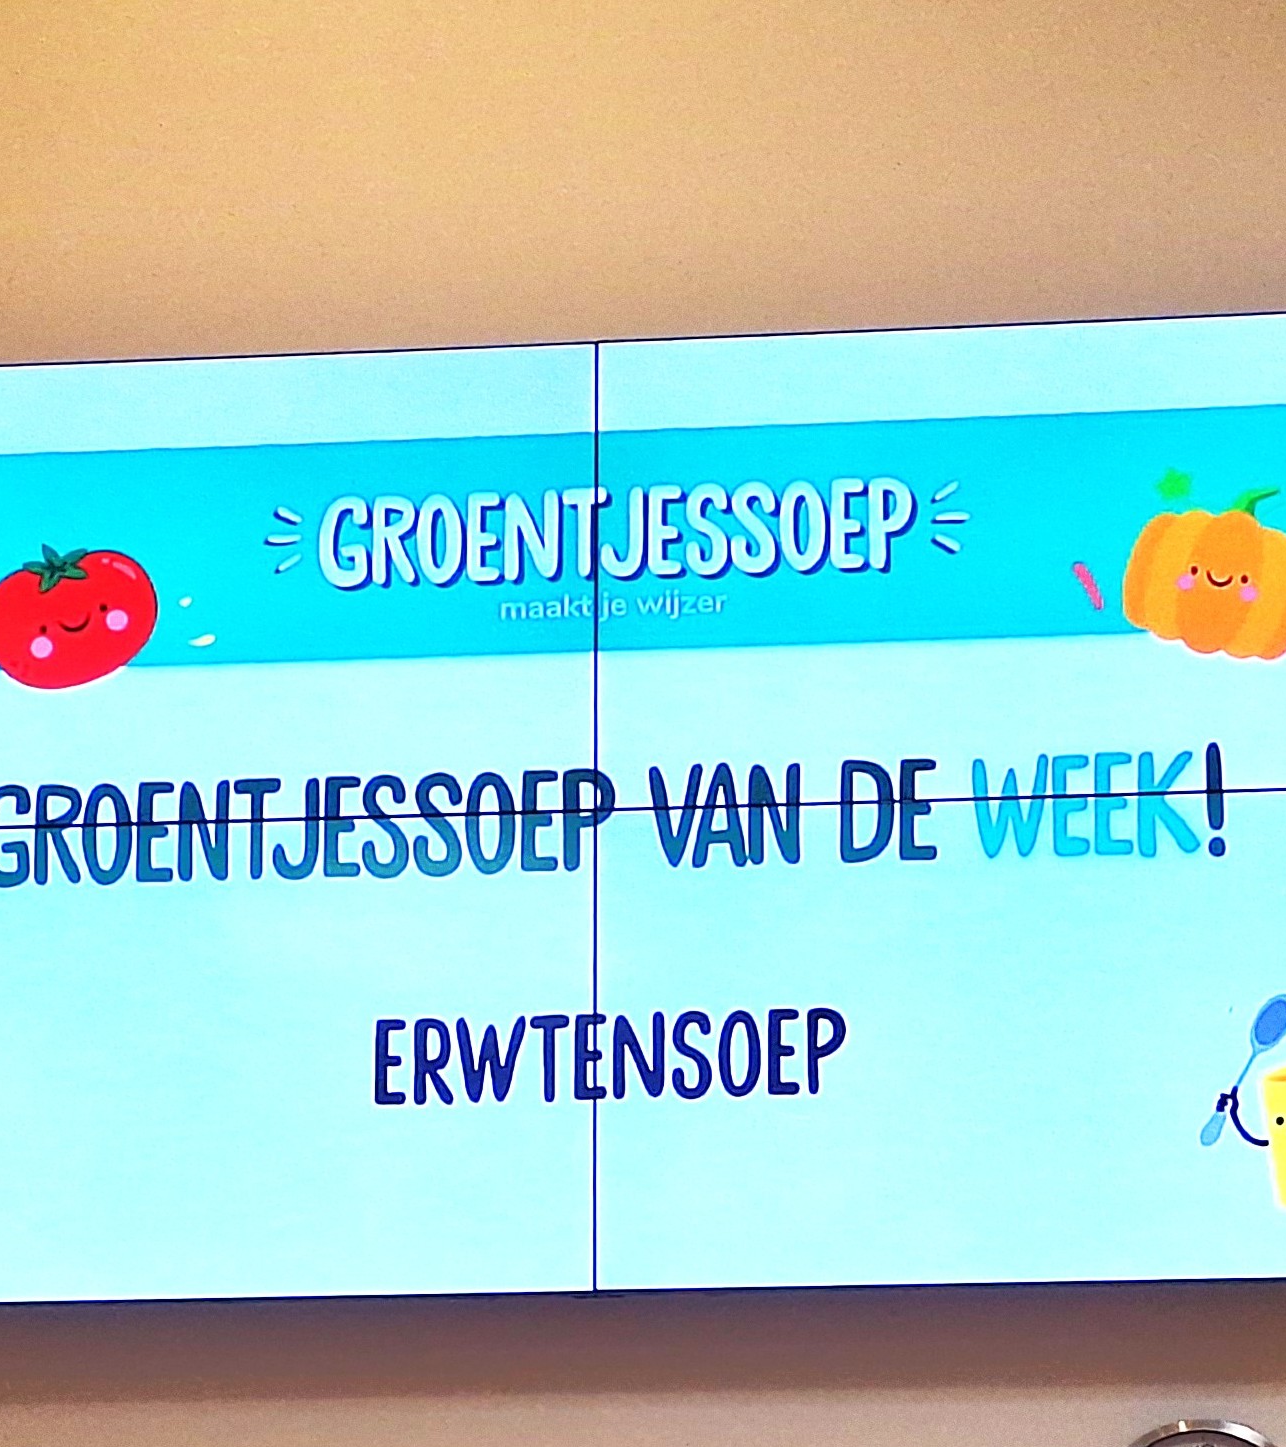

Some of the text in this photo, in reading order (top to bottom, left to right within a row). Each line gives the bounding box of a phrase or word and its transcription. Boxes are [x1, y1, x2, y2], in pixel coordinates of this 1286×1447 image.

[318, 476, 918, 591] GROENTJESSOEP
[500, 588, 727, 622] maakt je wijzer
[649, 762, 800, 867] VAN
[840, 759, 937, 863] DE
[972, 742, 1226, 859] WEEK!
[374, 1007, 847, 1105] ERWTENSOEP
